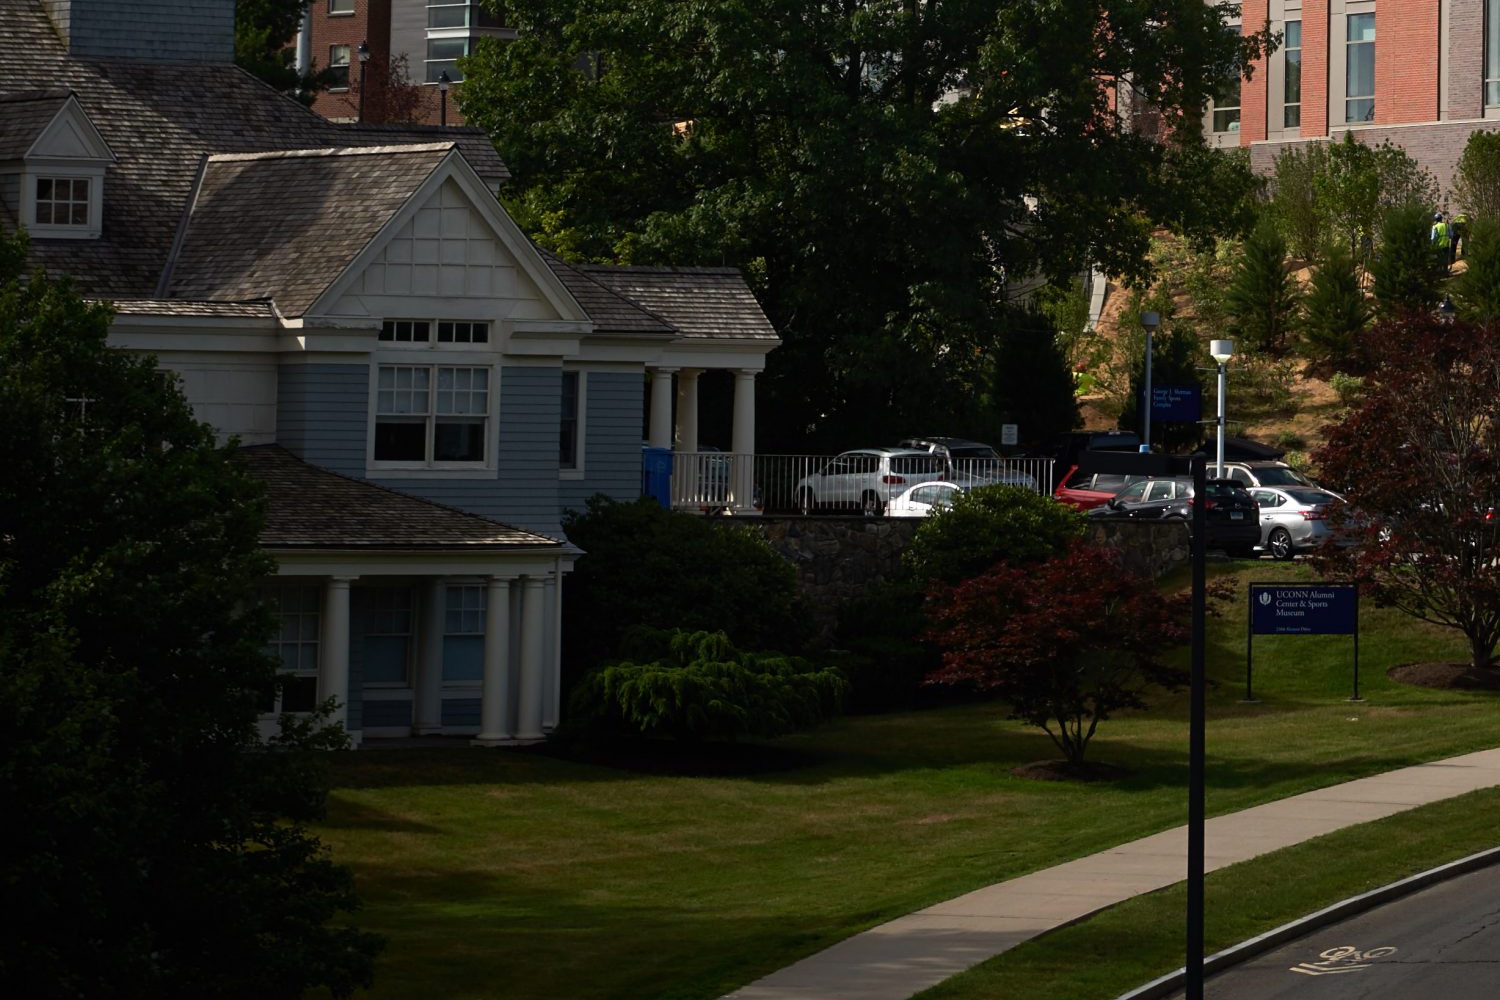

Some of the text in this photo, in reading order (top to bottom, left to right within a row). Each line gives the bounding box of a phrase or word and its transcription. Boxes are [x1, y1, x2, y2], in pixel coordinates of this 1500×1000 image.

[1276, 590, 1335, 599] UCONN Alumni
[1275, 599, 1328, 609] Center & Sports
[1275, 608, 1305, 616] Museum
